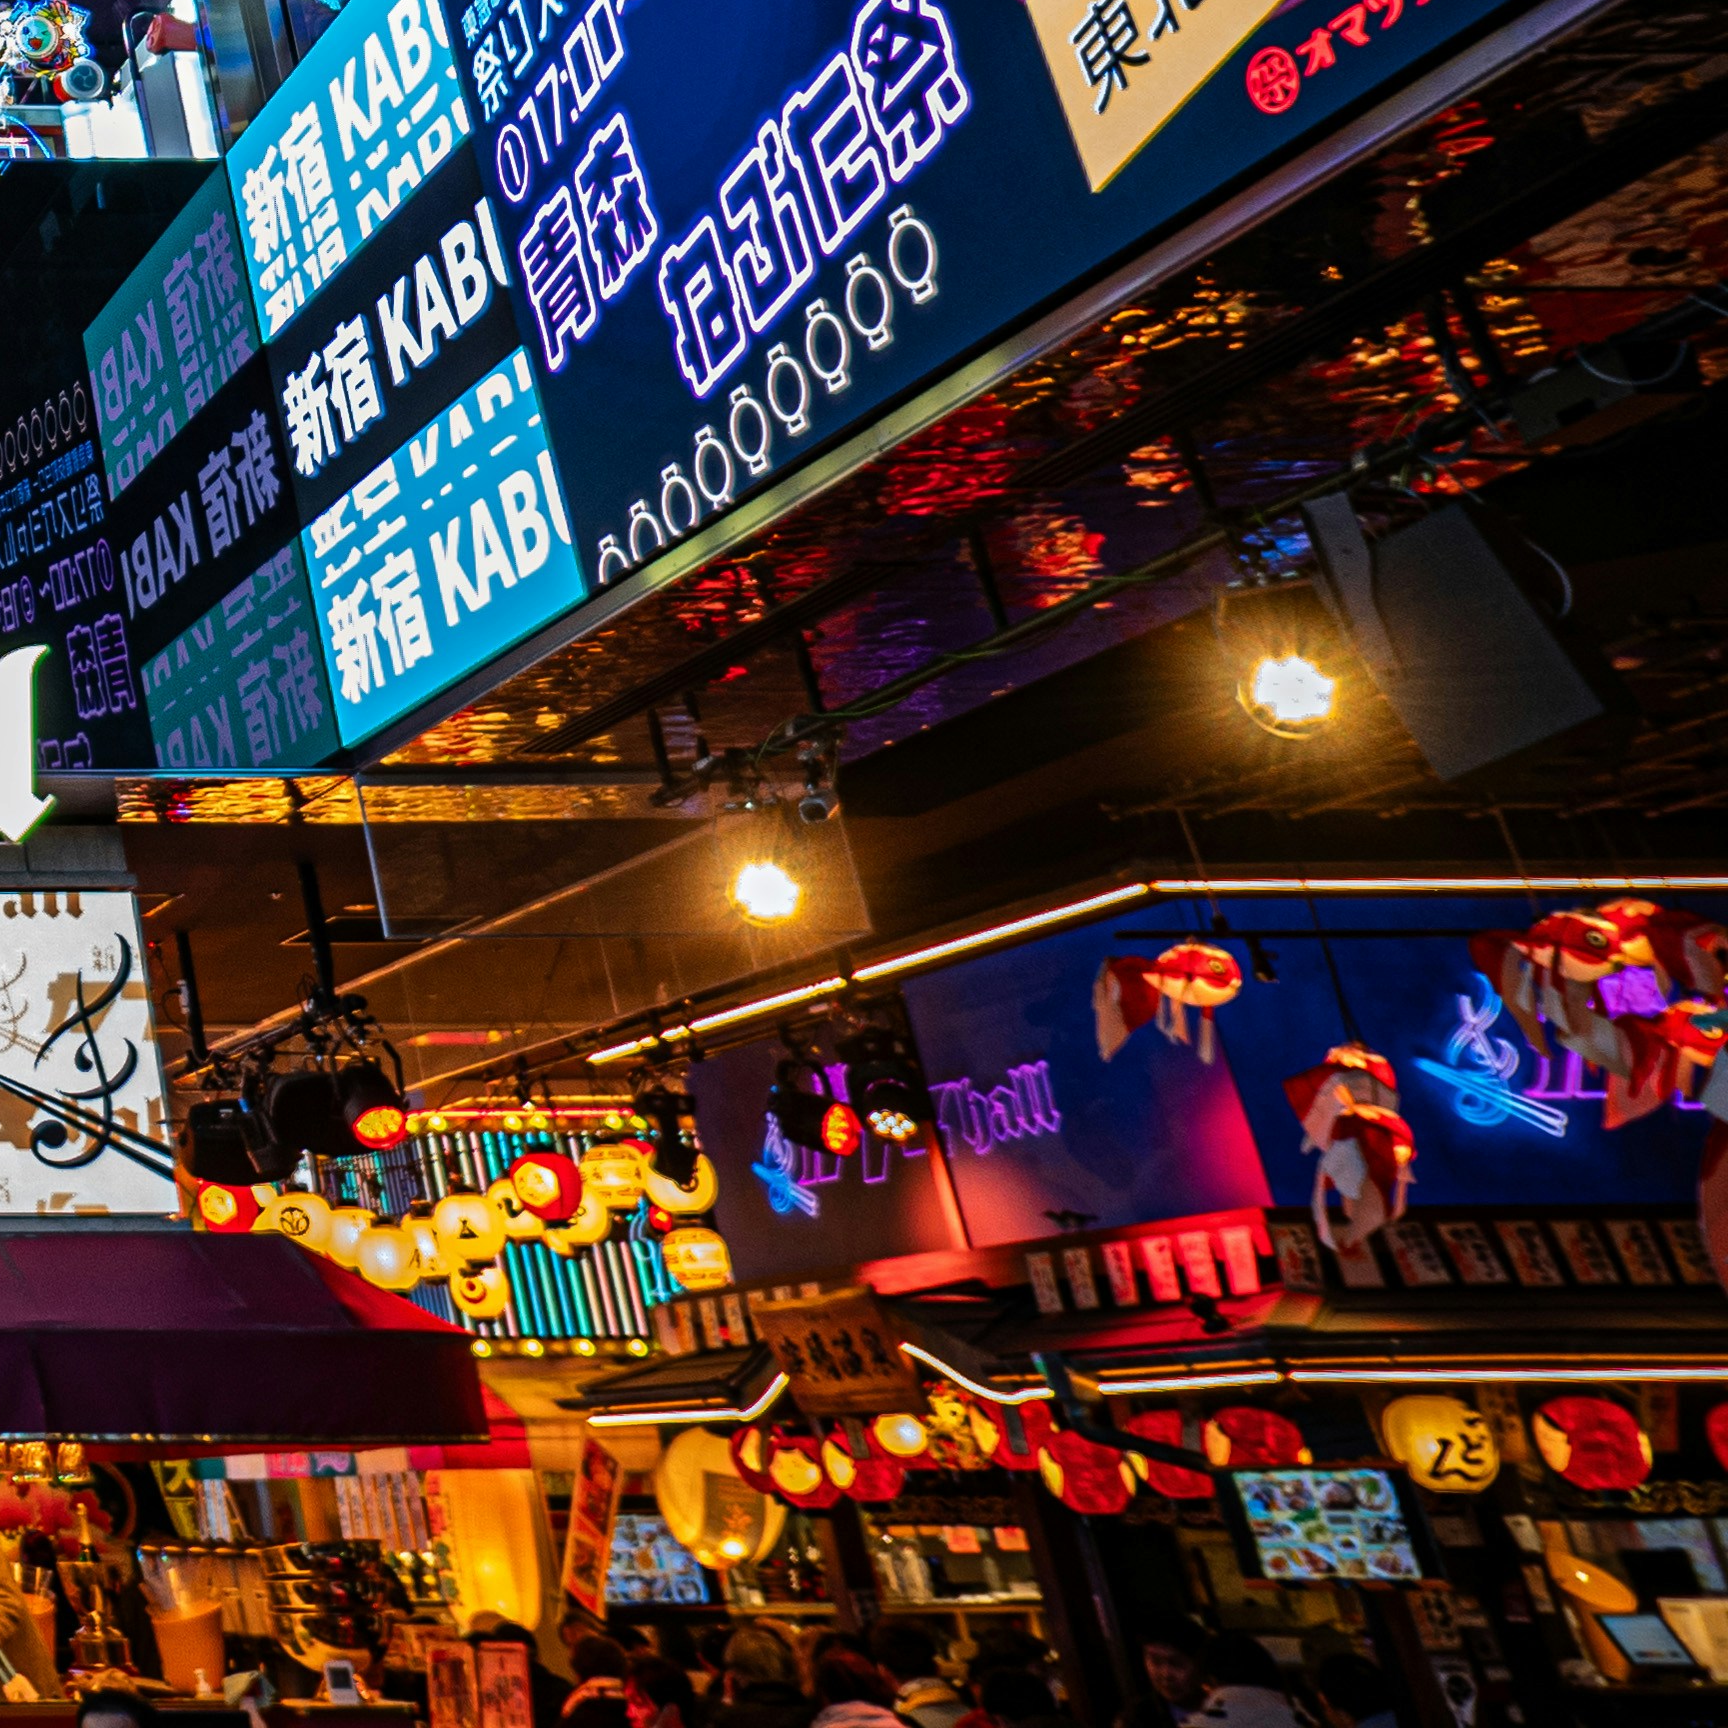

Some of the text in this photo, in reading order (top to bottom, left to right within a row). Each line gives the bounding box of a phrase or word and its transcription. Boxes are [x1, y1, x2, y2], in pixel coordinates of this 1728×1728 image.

[241, 108, 330, 265] 新宿
[283, 313, 378, 476] 新宿
[329, 561, 433, 703] 新宿
